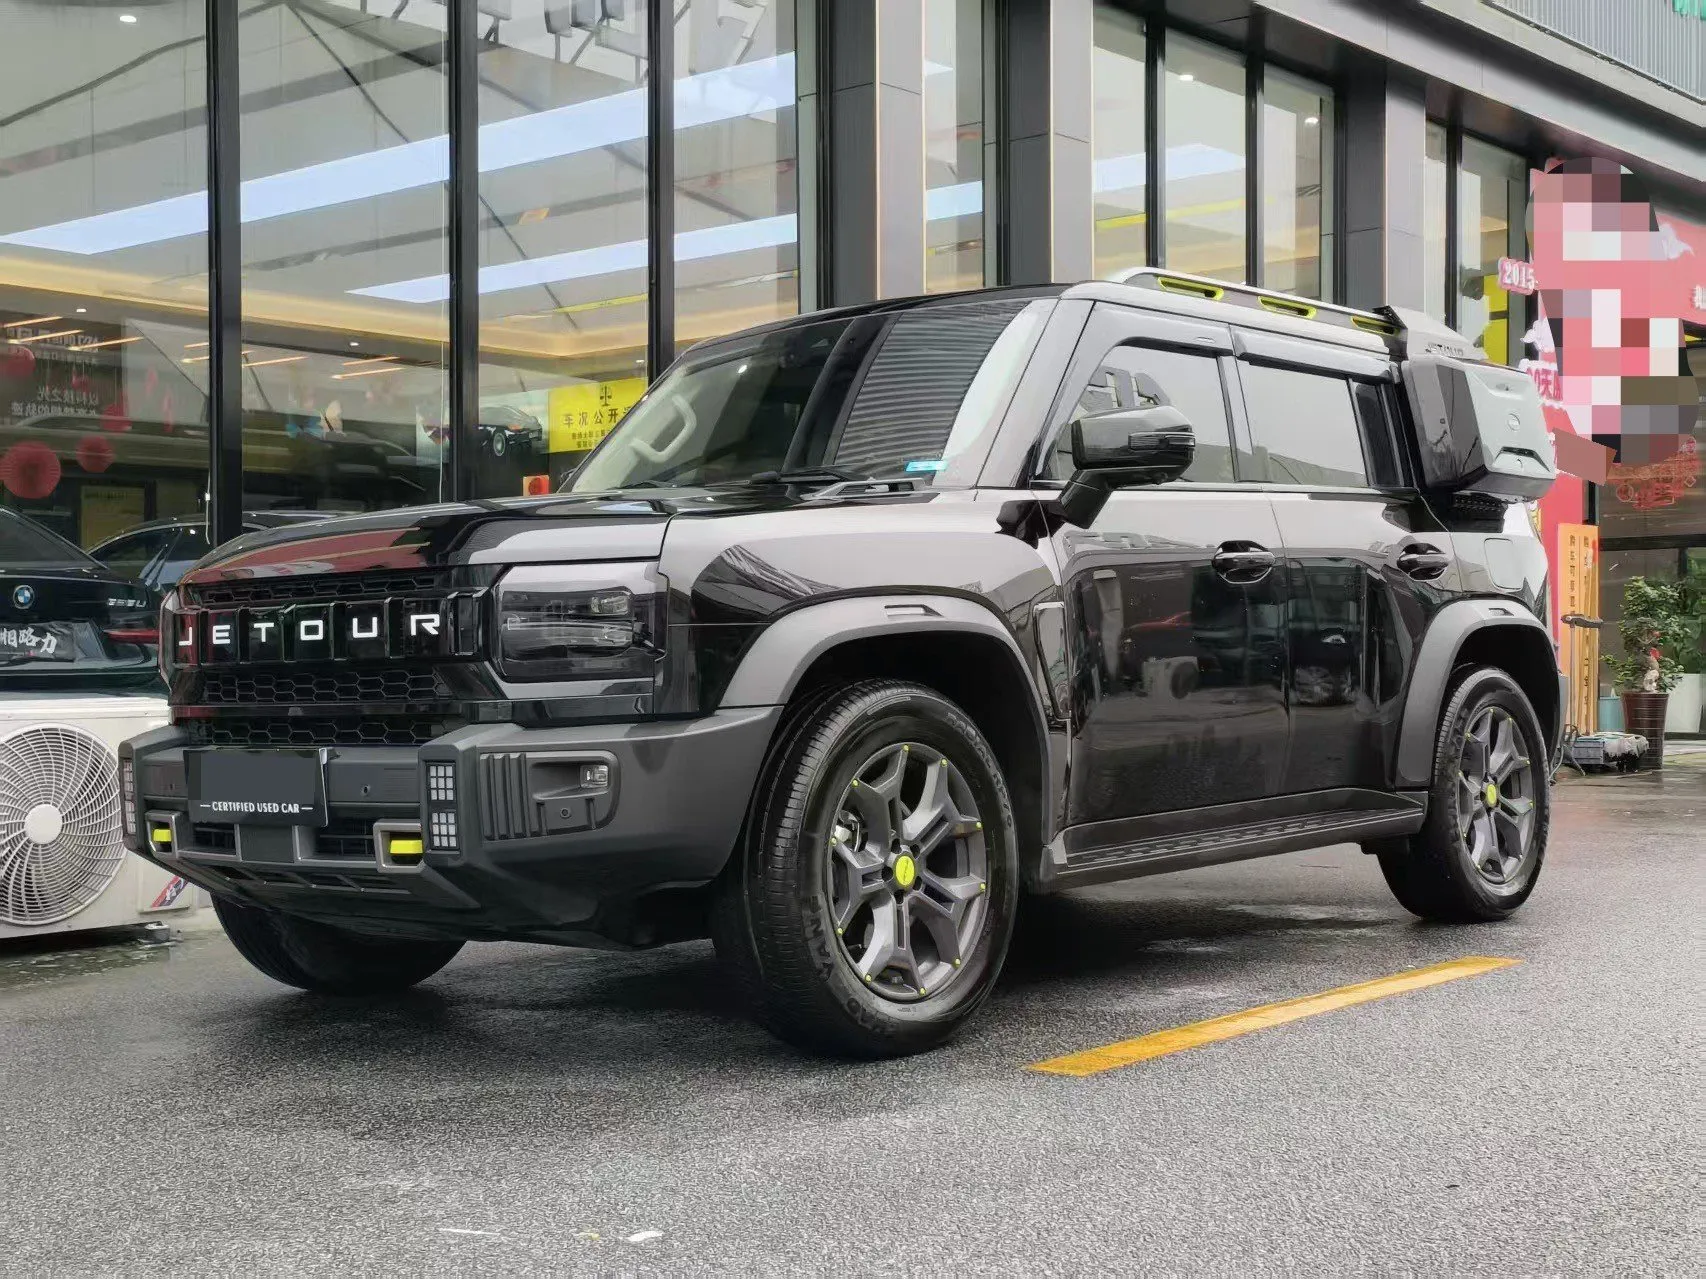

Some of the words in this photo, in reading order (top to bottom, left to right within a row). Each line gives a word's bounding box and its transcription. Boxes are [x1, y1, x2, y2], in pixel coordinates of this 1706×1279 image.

[178, 613, 441, 646] JETOUR
[212, 801, 255, 812] CERTIFIED
[257, 802, 279, 813] USED
[281, 803, 300, 814] CAR
